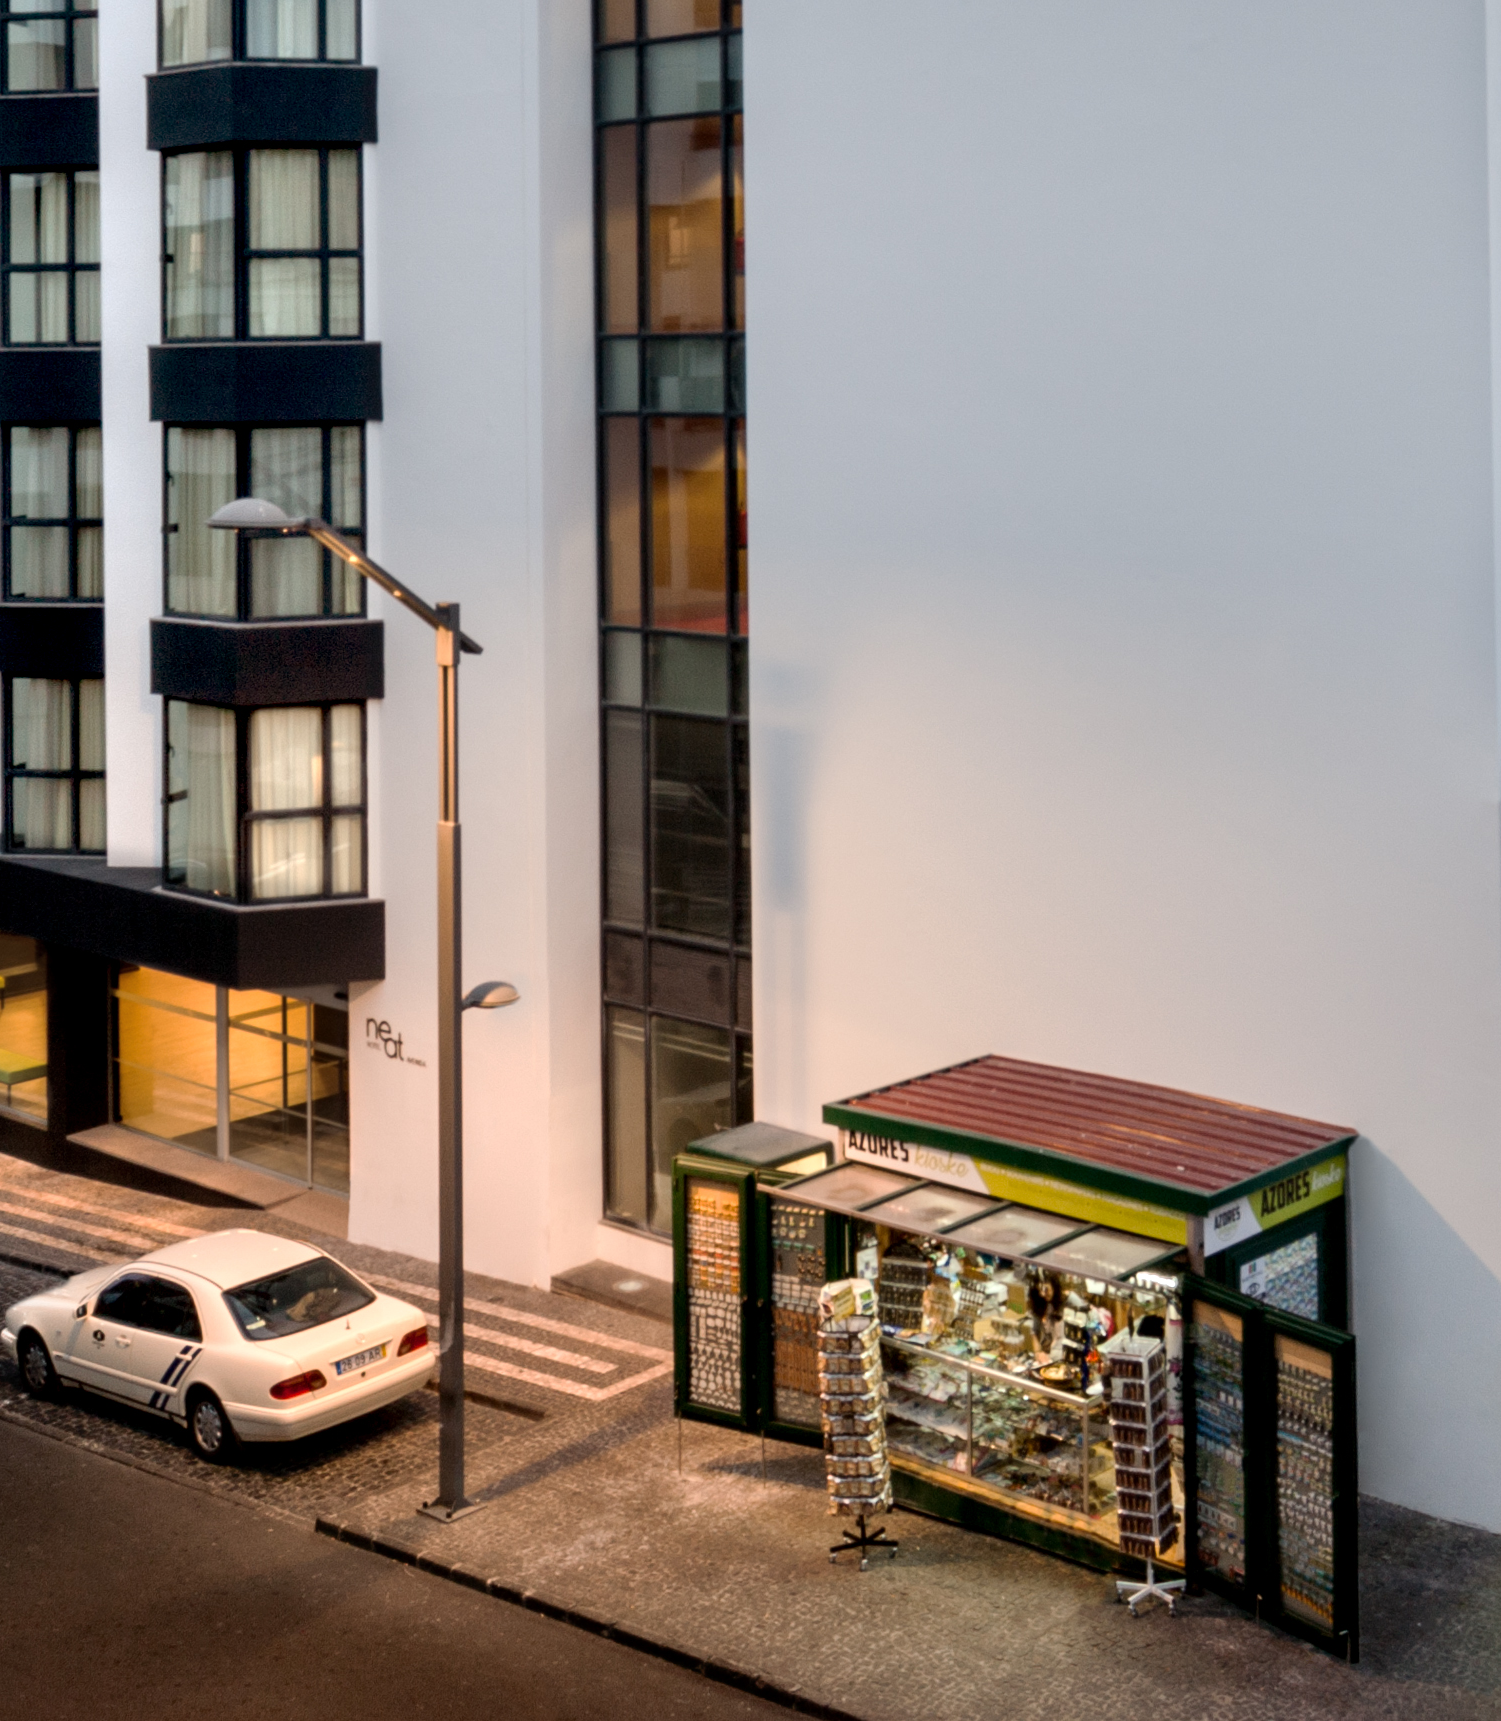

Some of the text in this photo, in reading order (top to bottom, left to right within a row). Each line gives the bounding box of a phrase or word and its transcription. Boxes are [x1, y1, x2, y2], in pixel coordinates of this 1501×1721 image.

[366, 1018, 404, 1062] neat
[848, 1129, 909, 1163] AZORES
[1261, 1170, 1310, 1218] AZORES
[1214, 1206, 1241, 1231] AZORES
